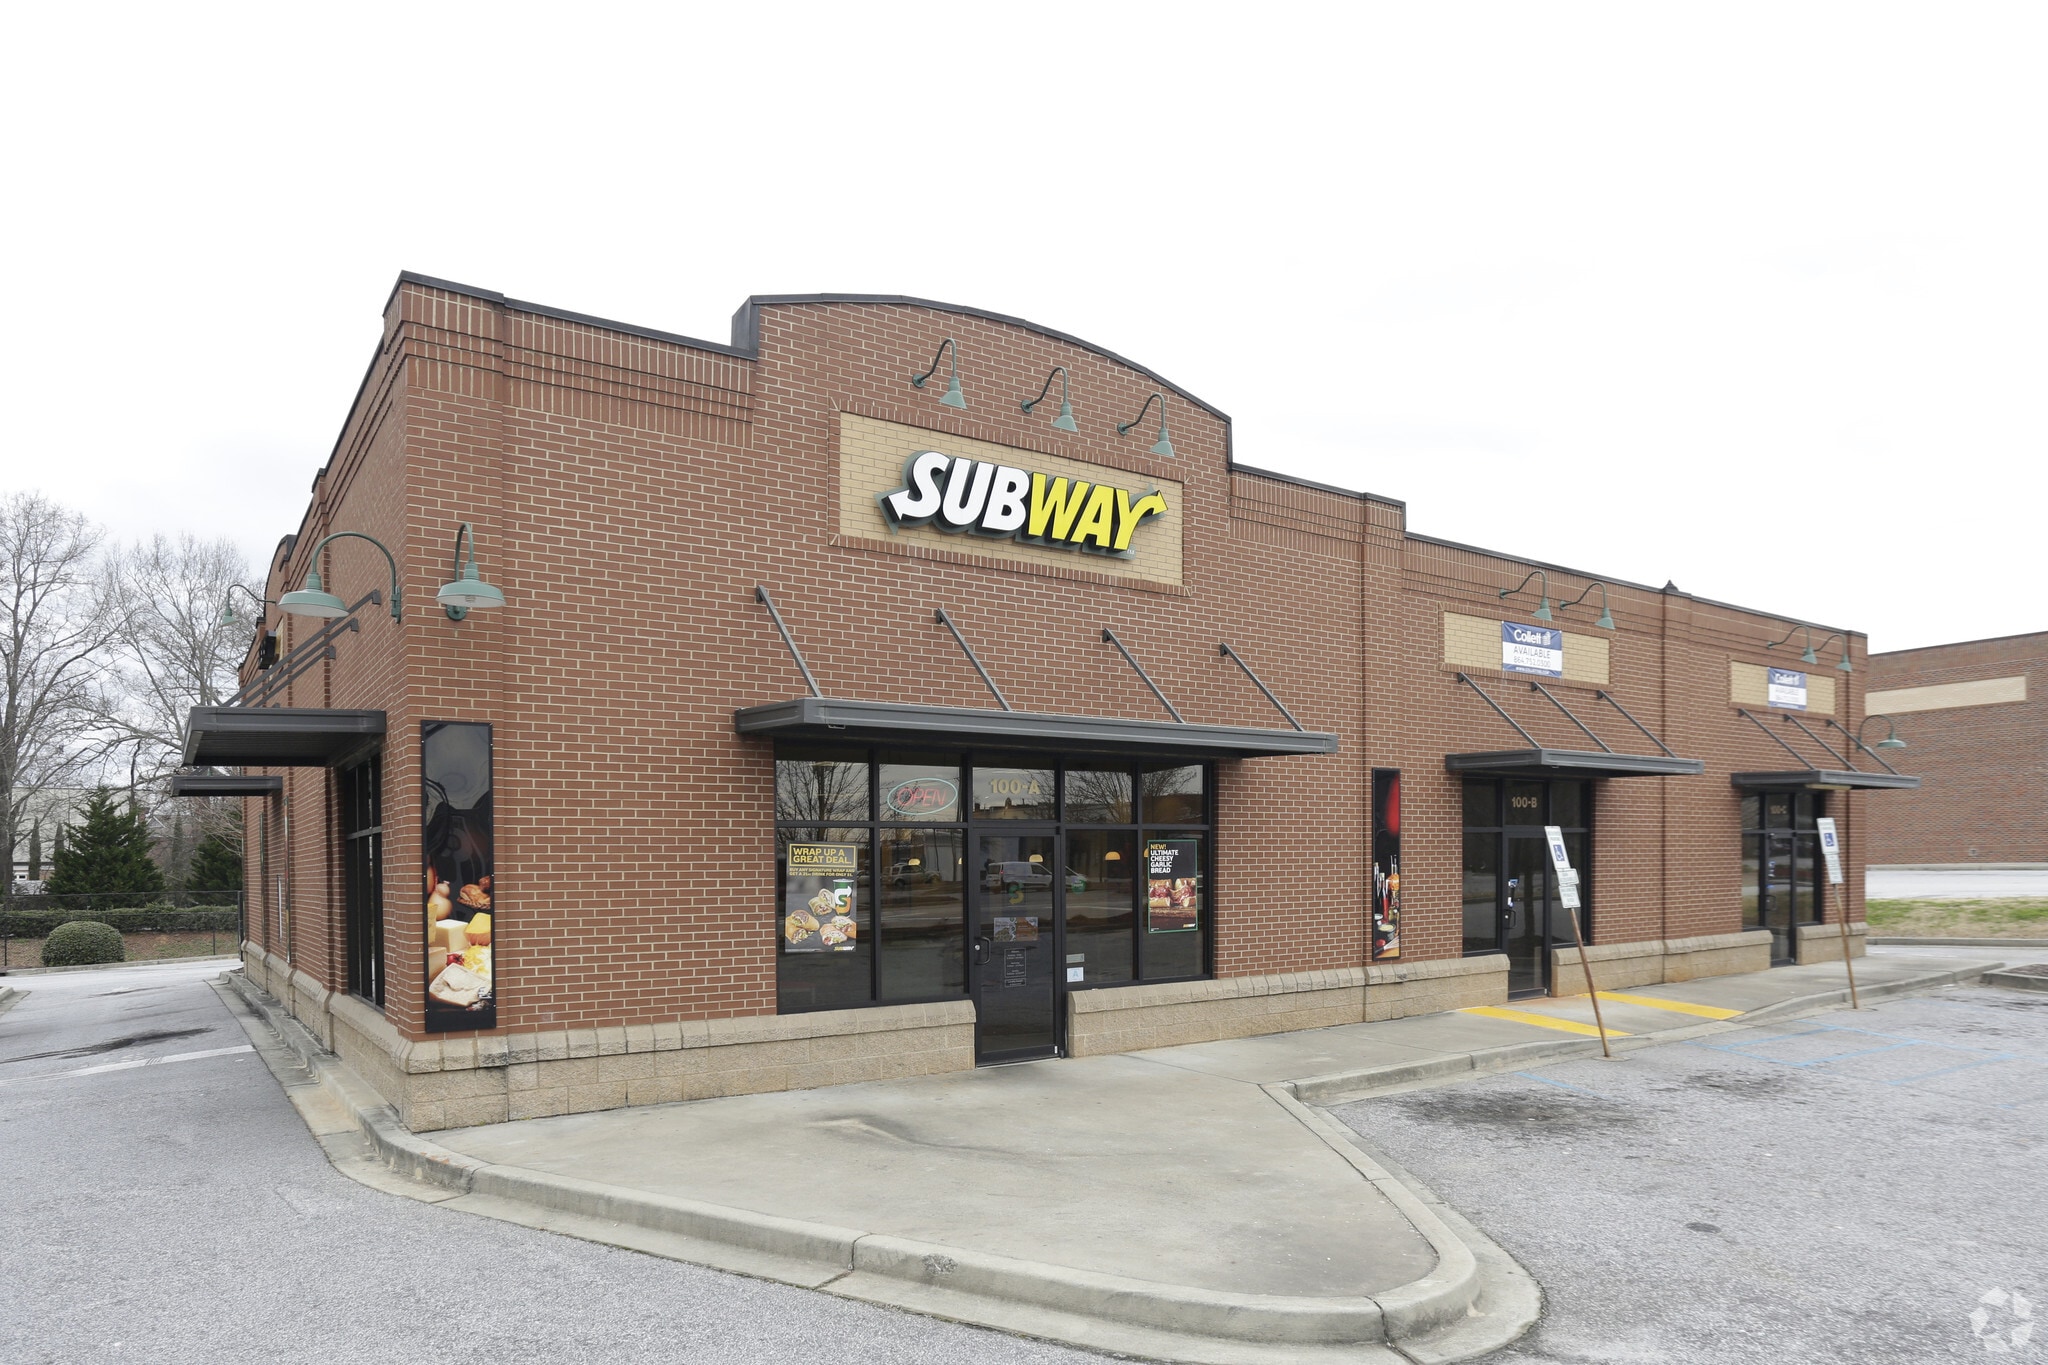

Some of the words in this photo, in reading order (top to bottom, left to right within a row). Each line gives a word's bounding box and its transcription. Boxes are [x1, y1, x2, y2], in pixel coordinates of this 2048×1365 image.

[887, 451, 1168, 550] SUBWAY
[1514, 646, 1551, 659] AVAILABLE
[991, 778, 1040, 794] 100-A
[898, 788, 947, 806] OPEN
[1512, 796, 1538, 808] 100-B
[793, 848, 822, 856] WRAP
